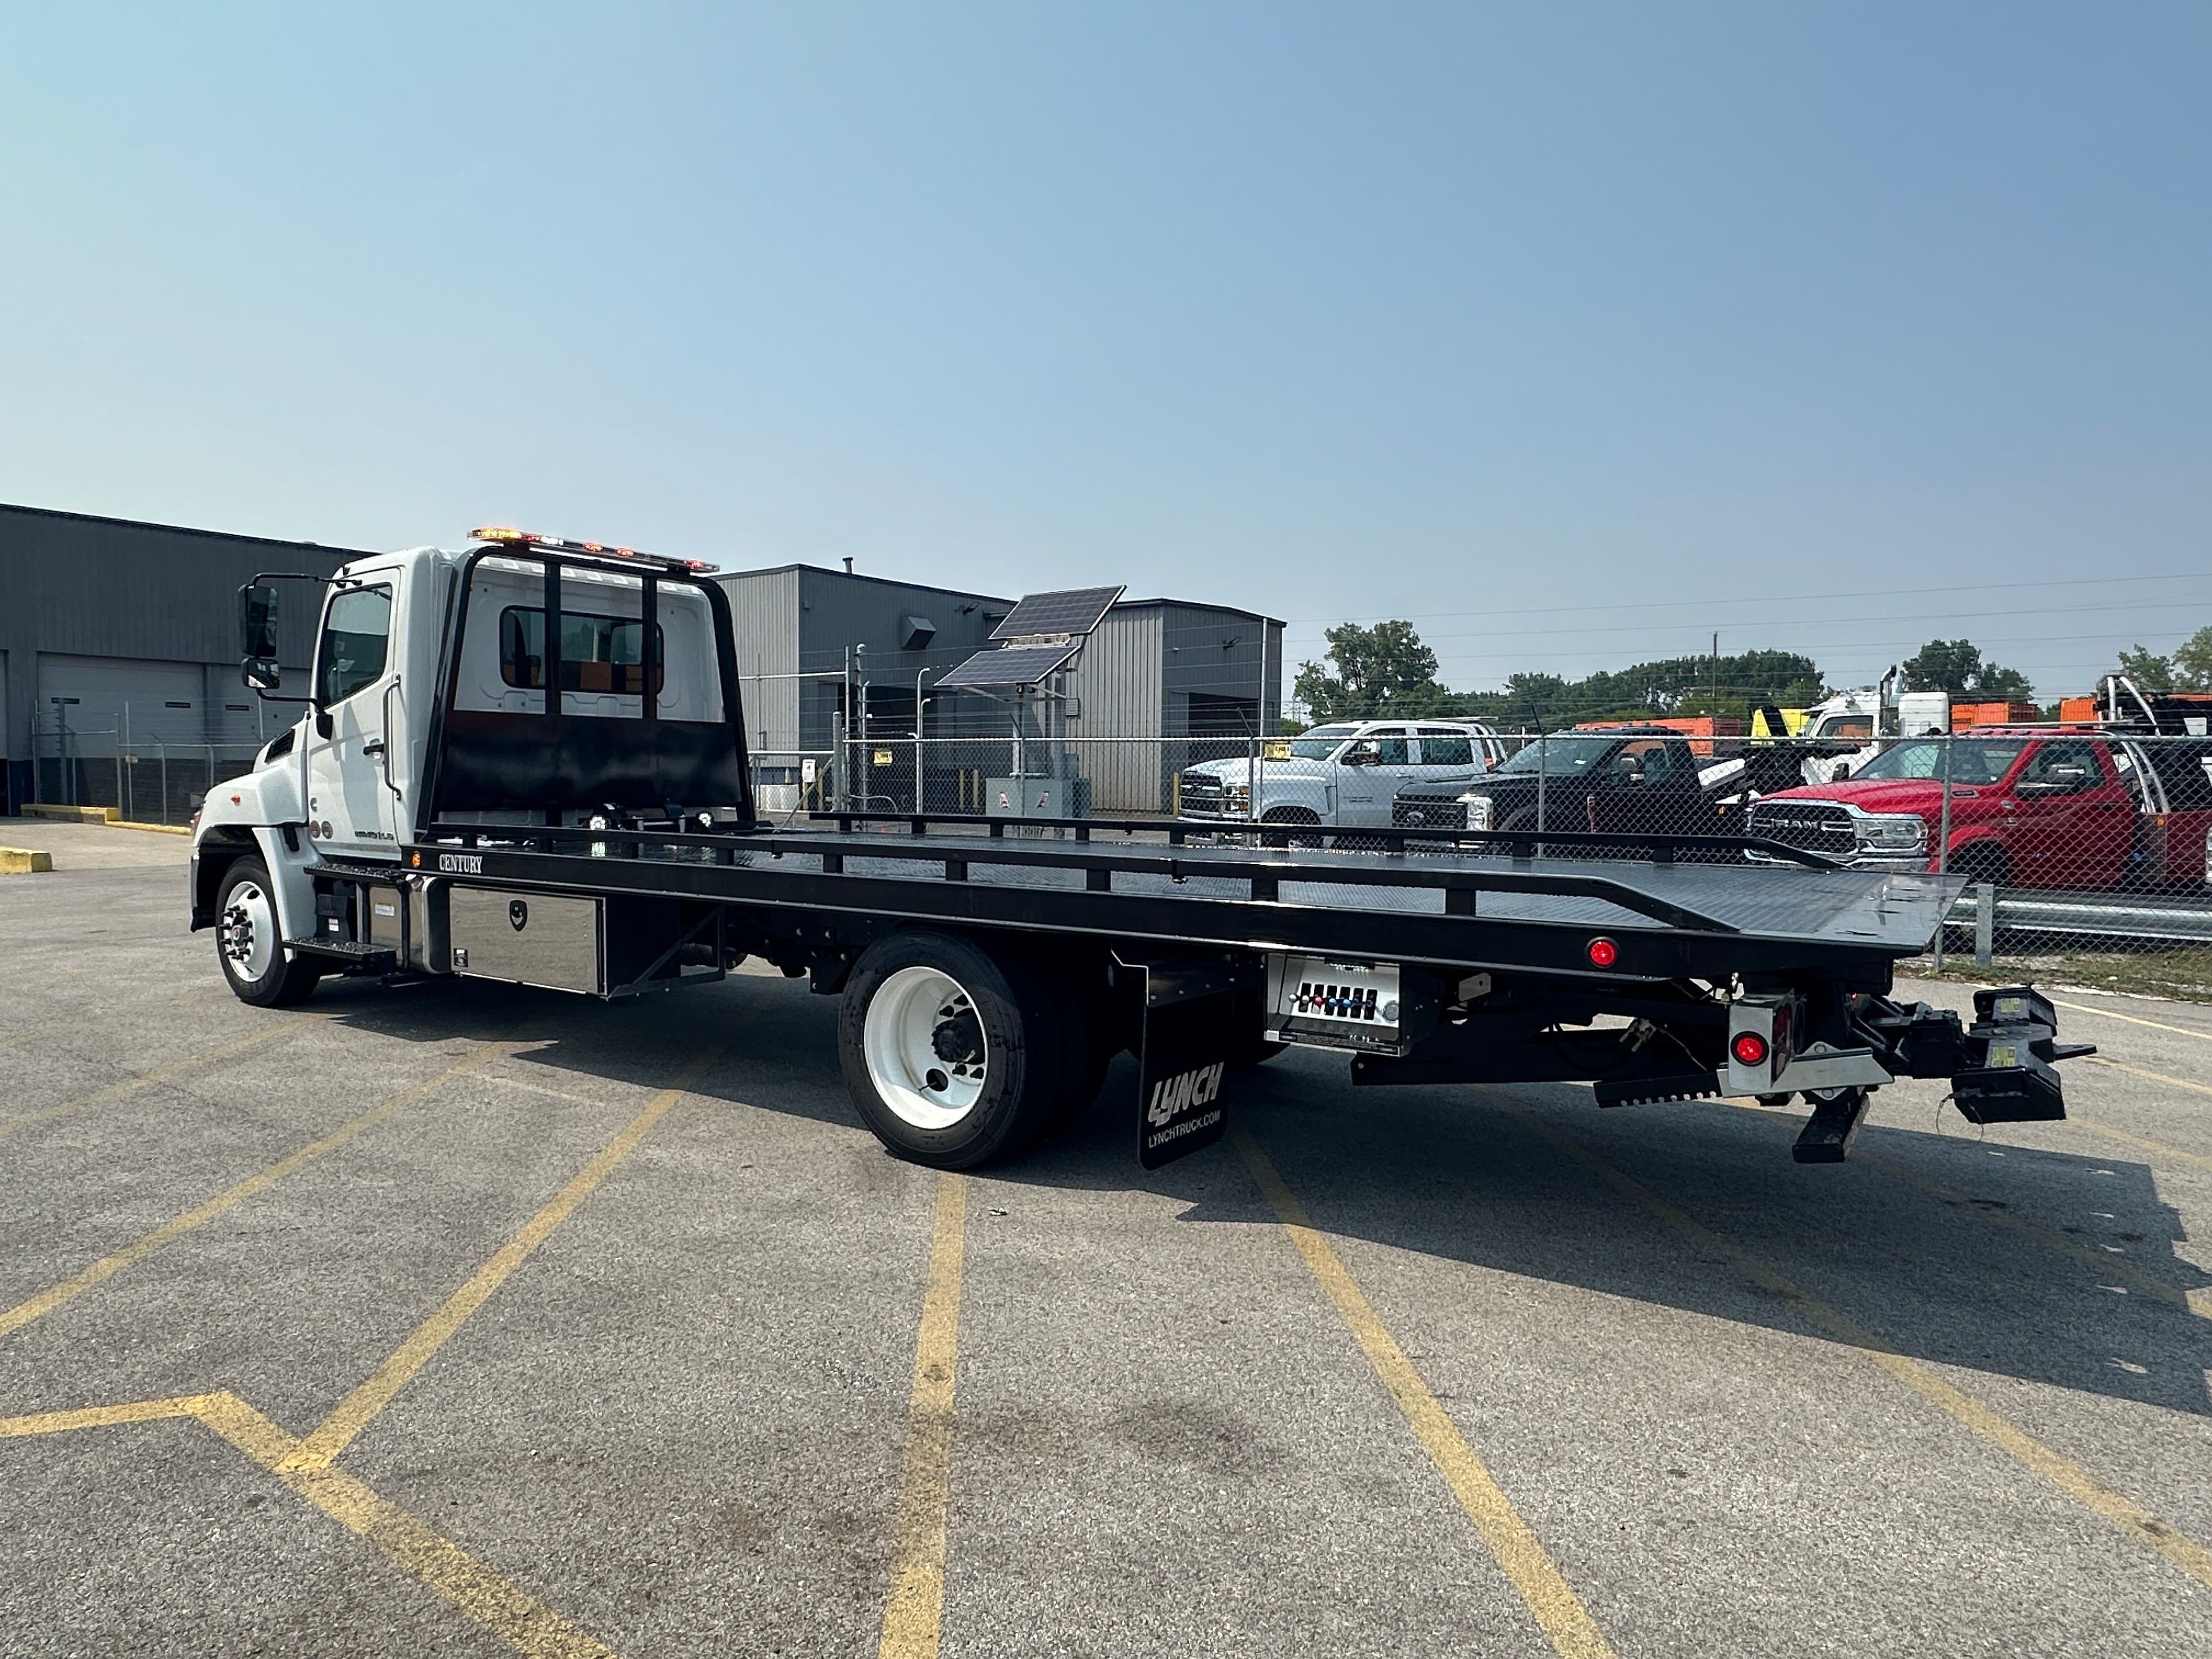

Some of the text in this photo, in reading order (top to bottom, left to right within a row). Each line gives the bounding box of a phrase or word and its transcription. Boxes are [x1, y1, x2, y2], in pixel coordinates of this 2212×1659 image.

[439, 854, 483, 873] CENTURY
[1148, 1061, 1224, 1127] LYNCH
[1149, 1109, 1221, 1149] LYNCHTRUCK.COM
